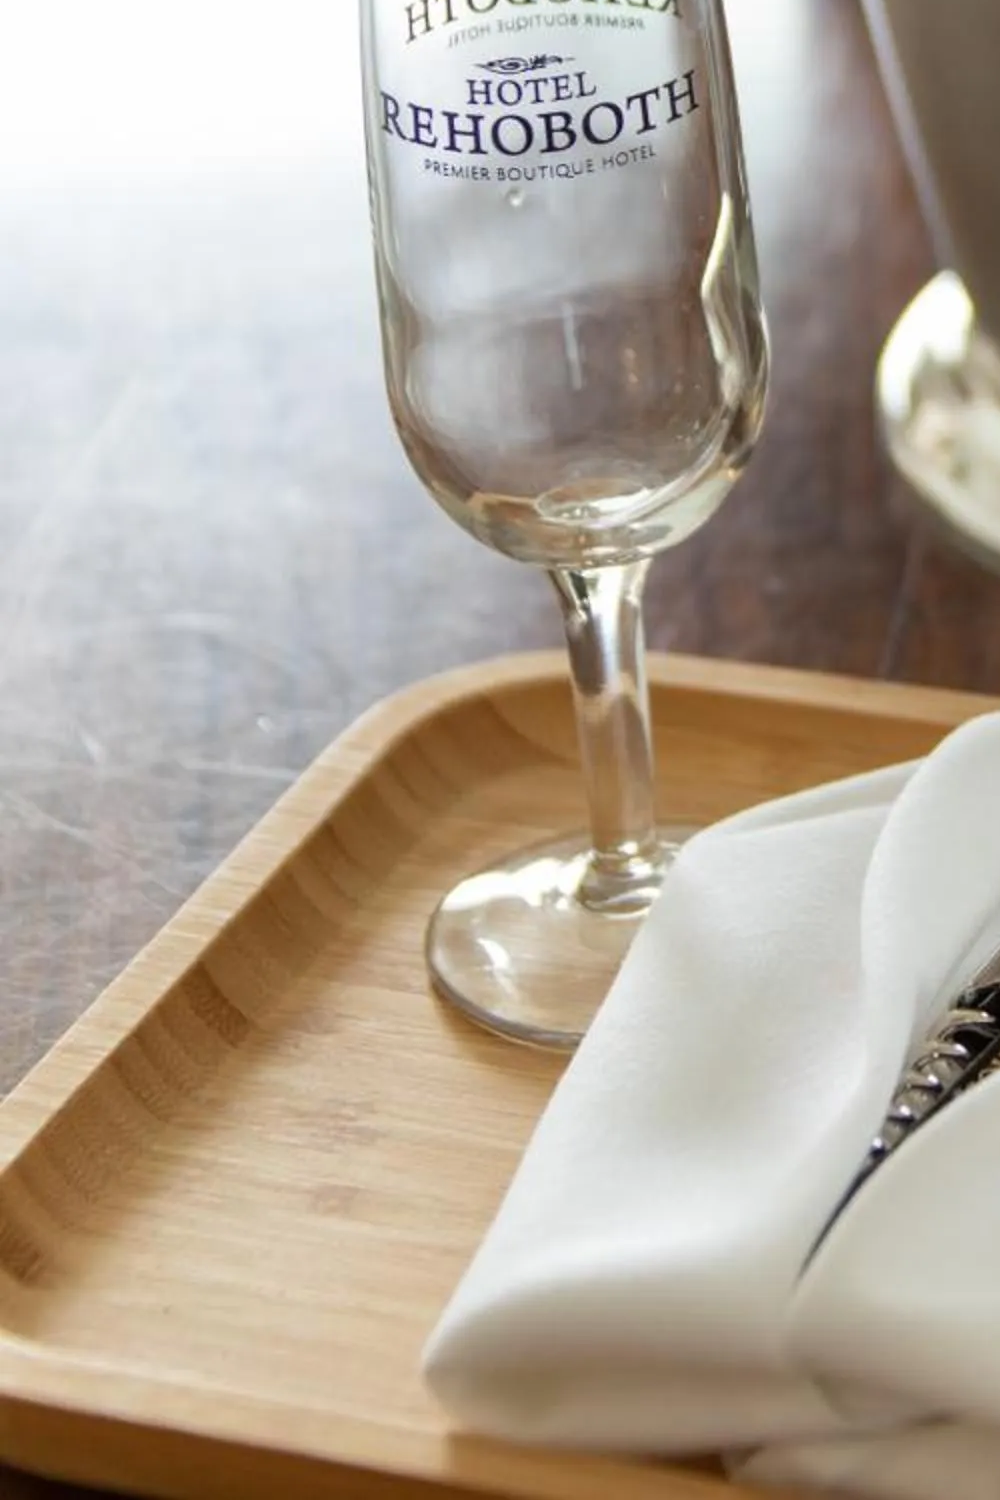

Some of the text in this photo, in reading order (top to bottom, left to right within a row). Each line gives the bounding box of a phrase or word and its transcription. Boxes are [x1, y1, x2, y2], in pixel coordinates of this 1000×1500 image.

[466, 71, 598, 106] HOTEL
[380, 69, 699, 157] REHOBOTH
[423, 144, 657, 181] PREMIER BOUTIQUE HOTEL
